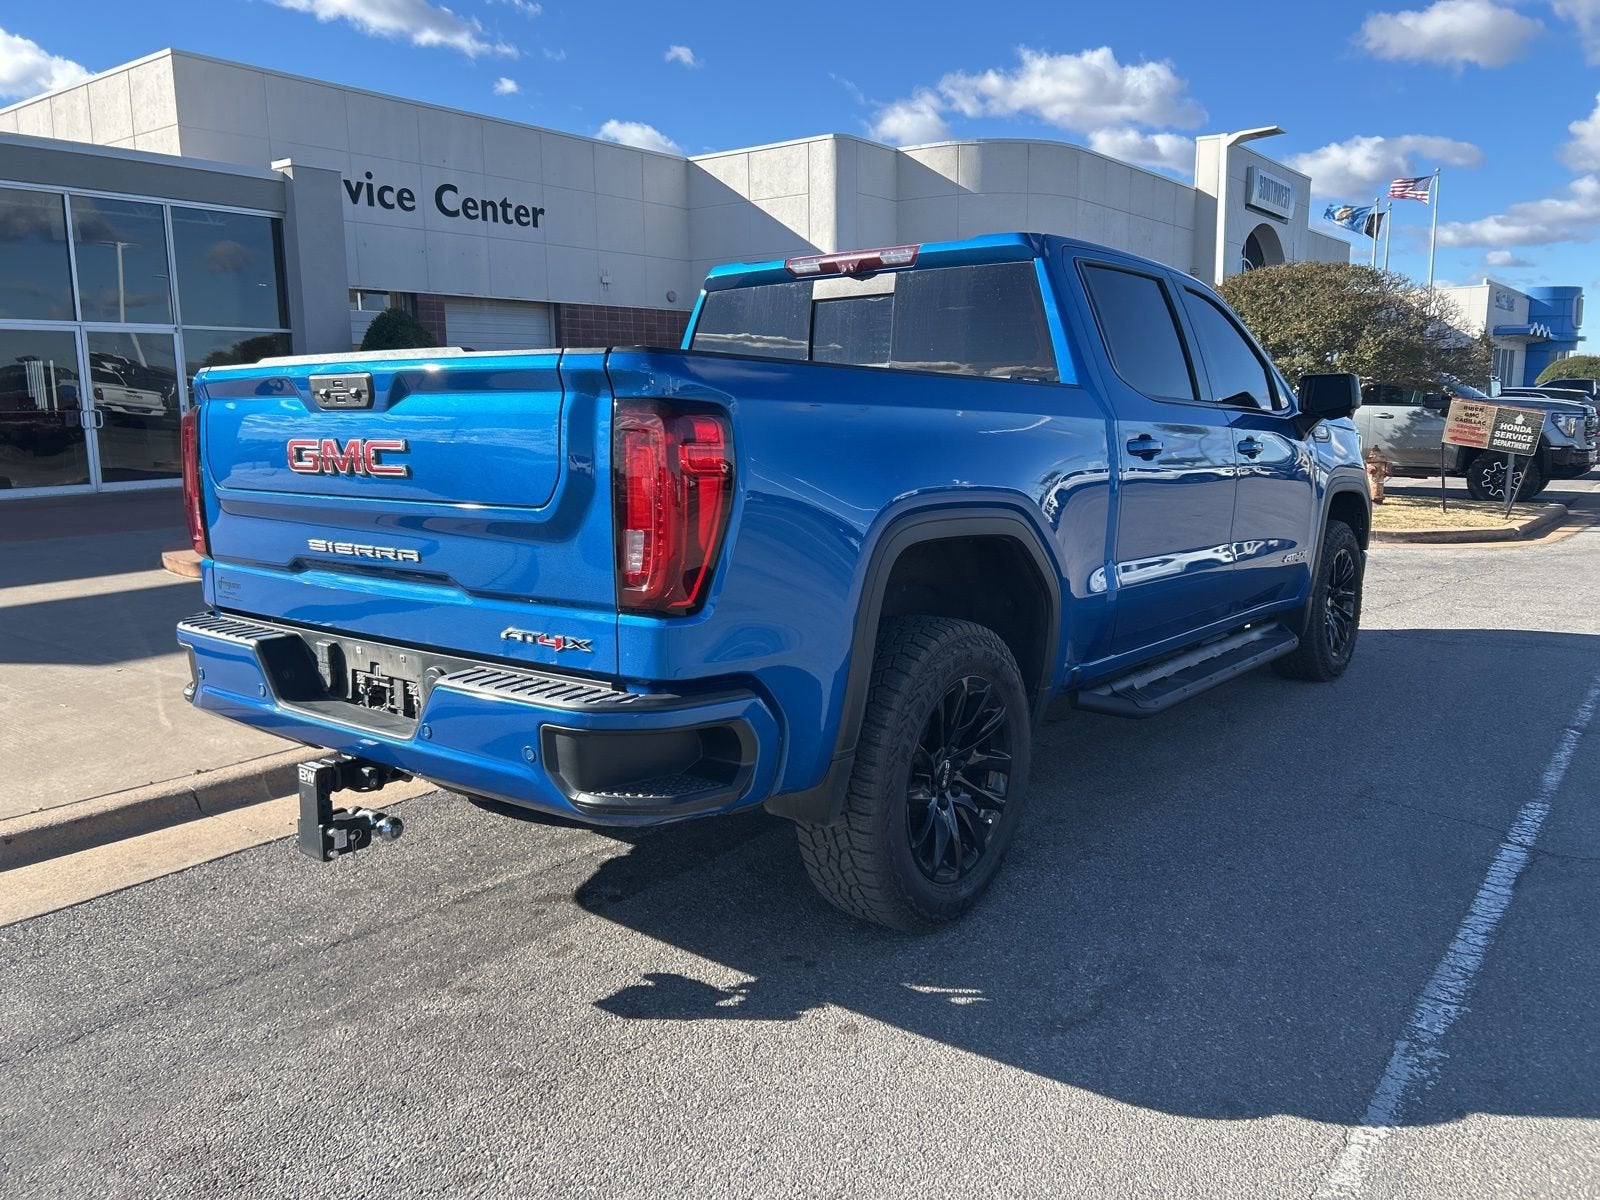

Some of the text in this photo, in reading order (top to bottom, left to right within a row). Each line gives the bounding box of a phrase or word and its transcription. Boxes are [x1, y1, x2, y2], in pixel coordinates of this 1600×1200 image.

[434, 183, 545, 228] Center
[1455, 417, 1487, 426] CADILLAC
[1500, 423, 1532, 434] HONDA
[1493, 440, 1531, 450] DEPARTMENT
[1494, 431, 1534, 443] SERVICE
[287, 438, 409, 478] GMC
[307, 538, 421, 564] SIERRA
[500, 626, 593, 653] AT4X
